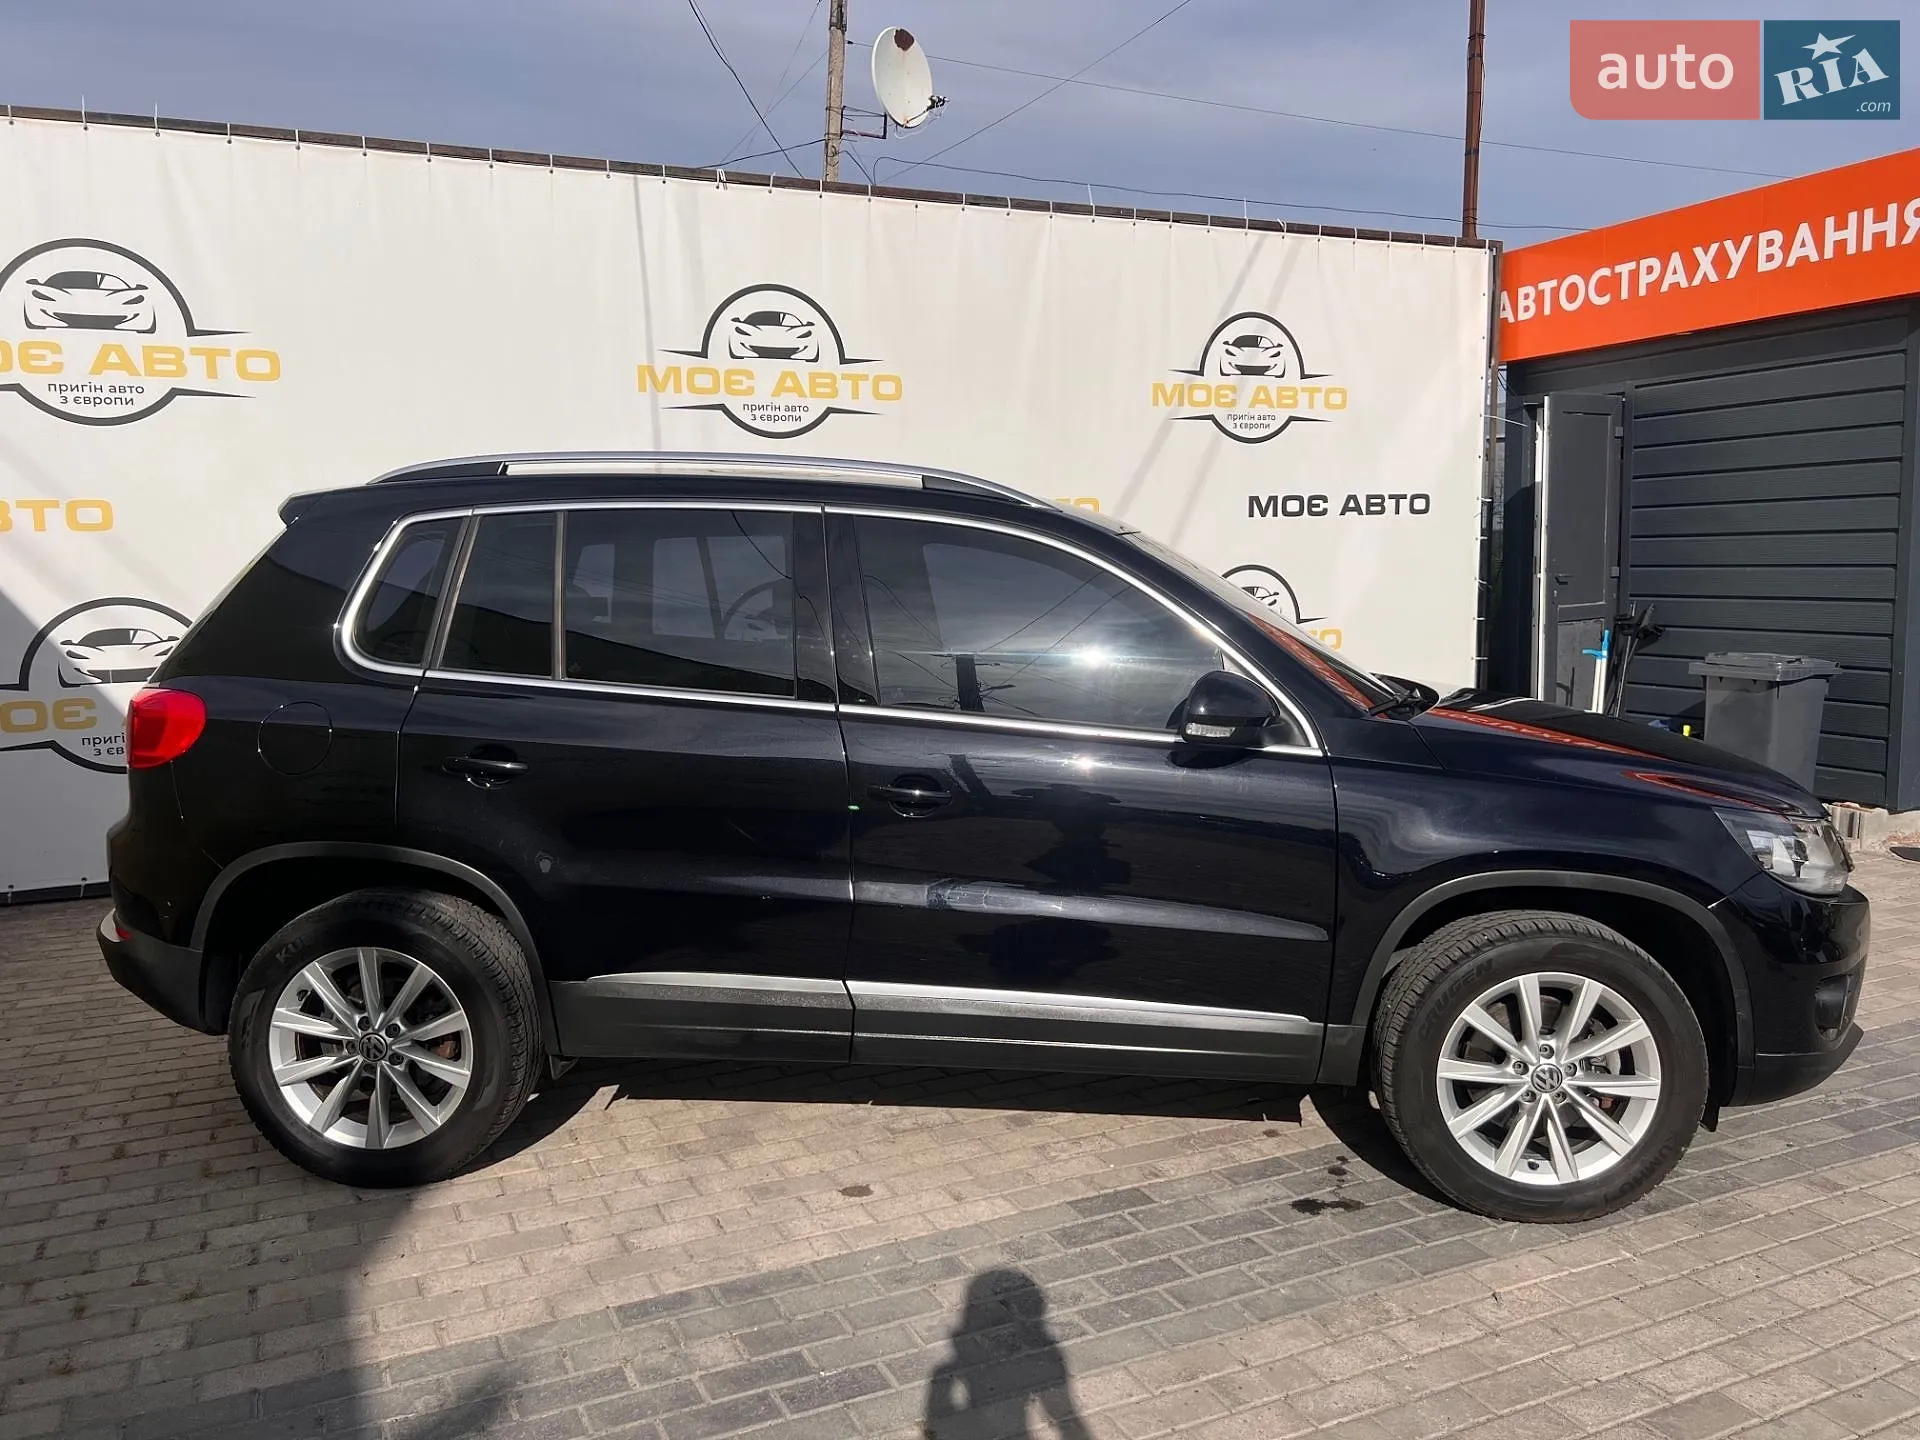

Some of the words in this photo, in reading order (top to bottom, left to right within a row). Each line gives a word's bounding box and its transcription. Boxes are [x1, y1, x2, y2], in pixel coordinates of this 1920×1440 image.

[1499, 197, 1920, 324] АВТОСТРАХУВАННЯ
[88, 343, 281, 382] АВТО
[47, 381, 103, 394] пригін
[108, 385, 145, 394] авто
[636, 365, 756, 397] МОЄ
[770, 370, 903, 401] АВТО
[59, 395, 69, 404] з
[73, 396, 134, 407] європи
[1152, 383, 1238, 408] МОЄ
[1248, 386, 1348, 410] АВТО
[742, 402, 781, 413] пригін
[750, 413, 757, 421] з
[760, 414, 802, 423] європи
[1257, 413, 1276, 421] авто
[1248, 495, 1329, 517] МОЄ
[1339, 493, 1431, 516] АВТО
[81, 732, 126, 747] пригі
